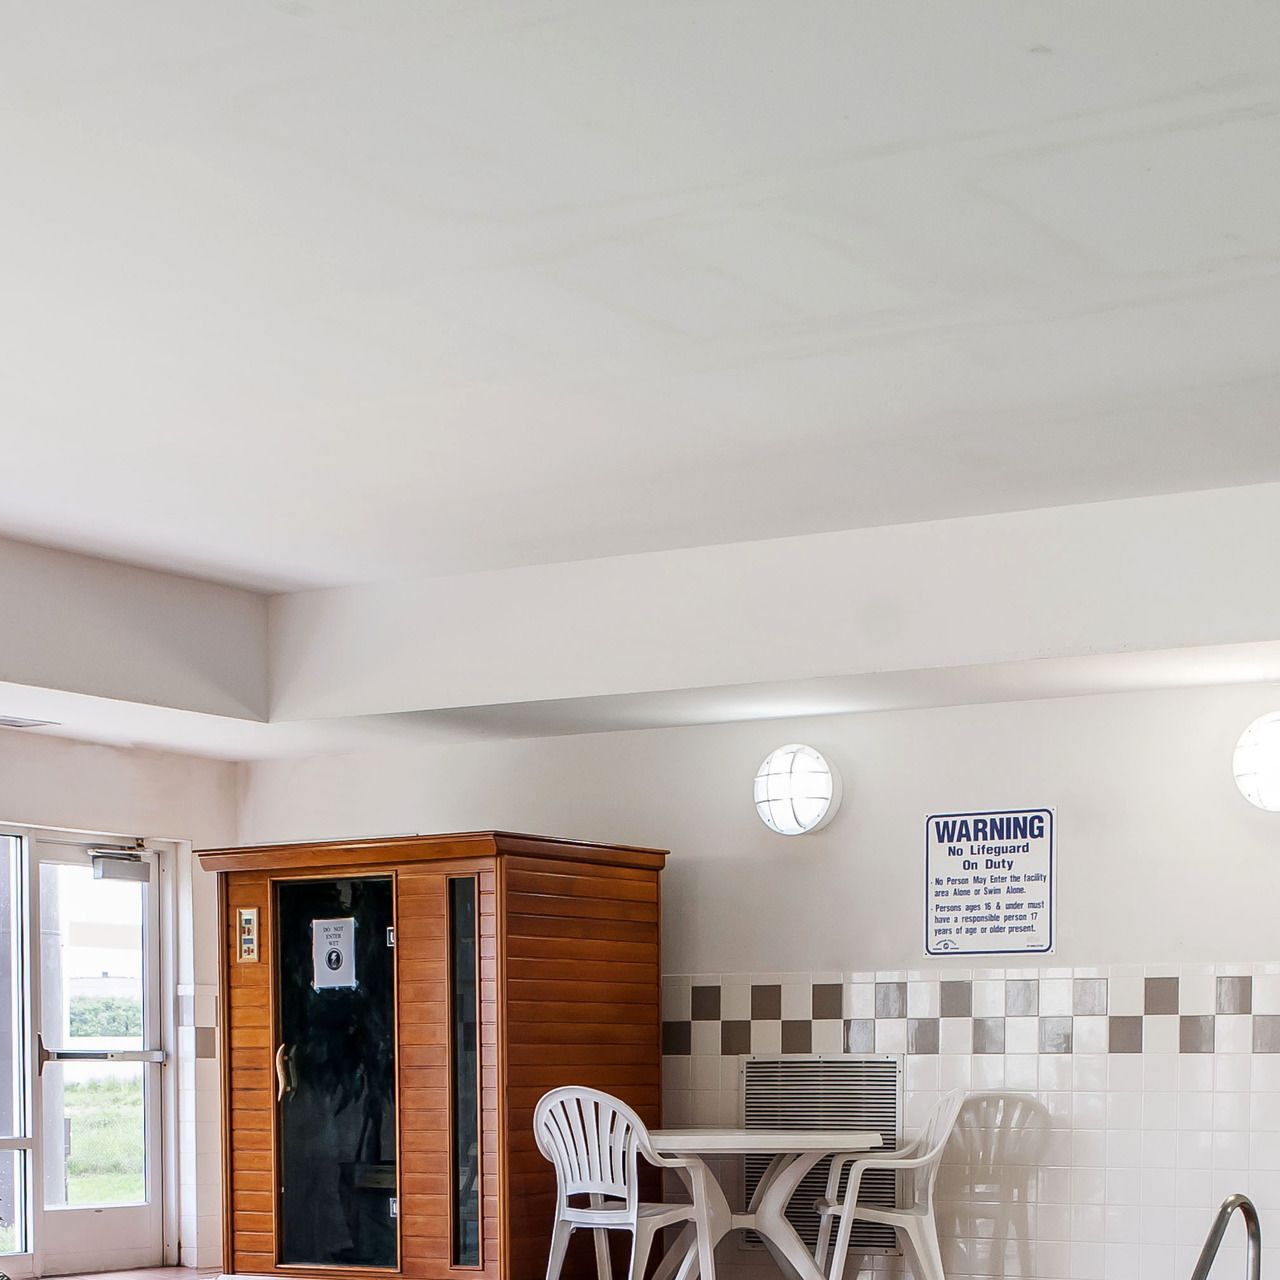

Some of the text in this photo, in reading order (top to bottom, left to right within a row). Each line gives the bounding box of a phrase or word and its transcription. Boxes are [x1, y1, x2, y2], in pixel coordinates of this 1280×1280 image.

[935, 815, 1044, 843] WARNING
[948, 842, 1030, 857] No Lifeguard
[963, 858, 1014, 871] On Duty
[935, 873, 1047, 886] No Person May Enter the facility
[934, 889, 949, 897] area
[953, 888, 970, 896] Alone
[984, 887, 1001, 895] Swim
[935, 904, 961, 912] Persons
[965, 903, 981, 912] ages
[995, 902, 1001, 910] &
[1005, 901, 1024, 910] under
[1027, 901, 1044, 909] must
[934, 915, 950, 924] have
[962, 913, 1000, 923] responsible
[1003, 913, 1027, 923] person
[1030, 912, 1038, 920] 17
[934, 926, 952, 936] years
[955, 926, 963, 934] of
[965, 926, 977, 935] age
[989, 925, 1006, 933] older
